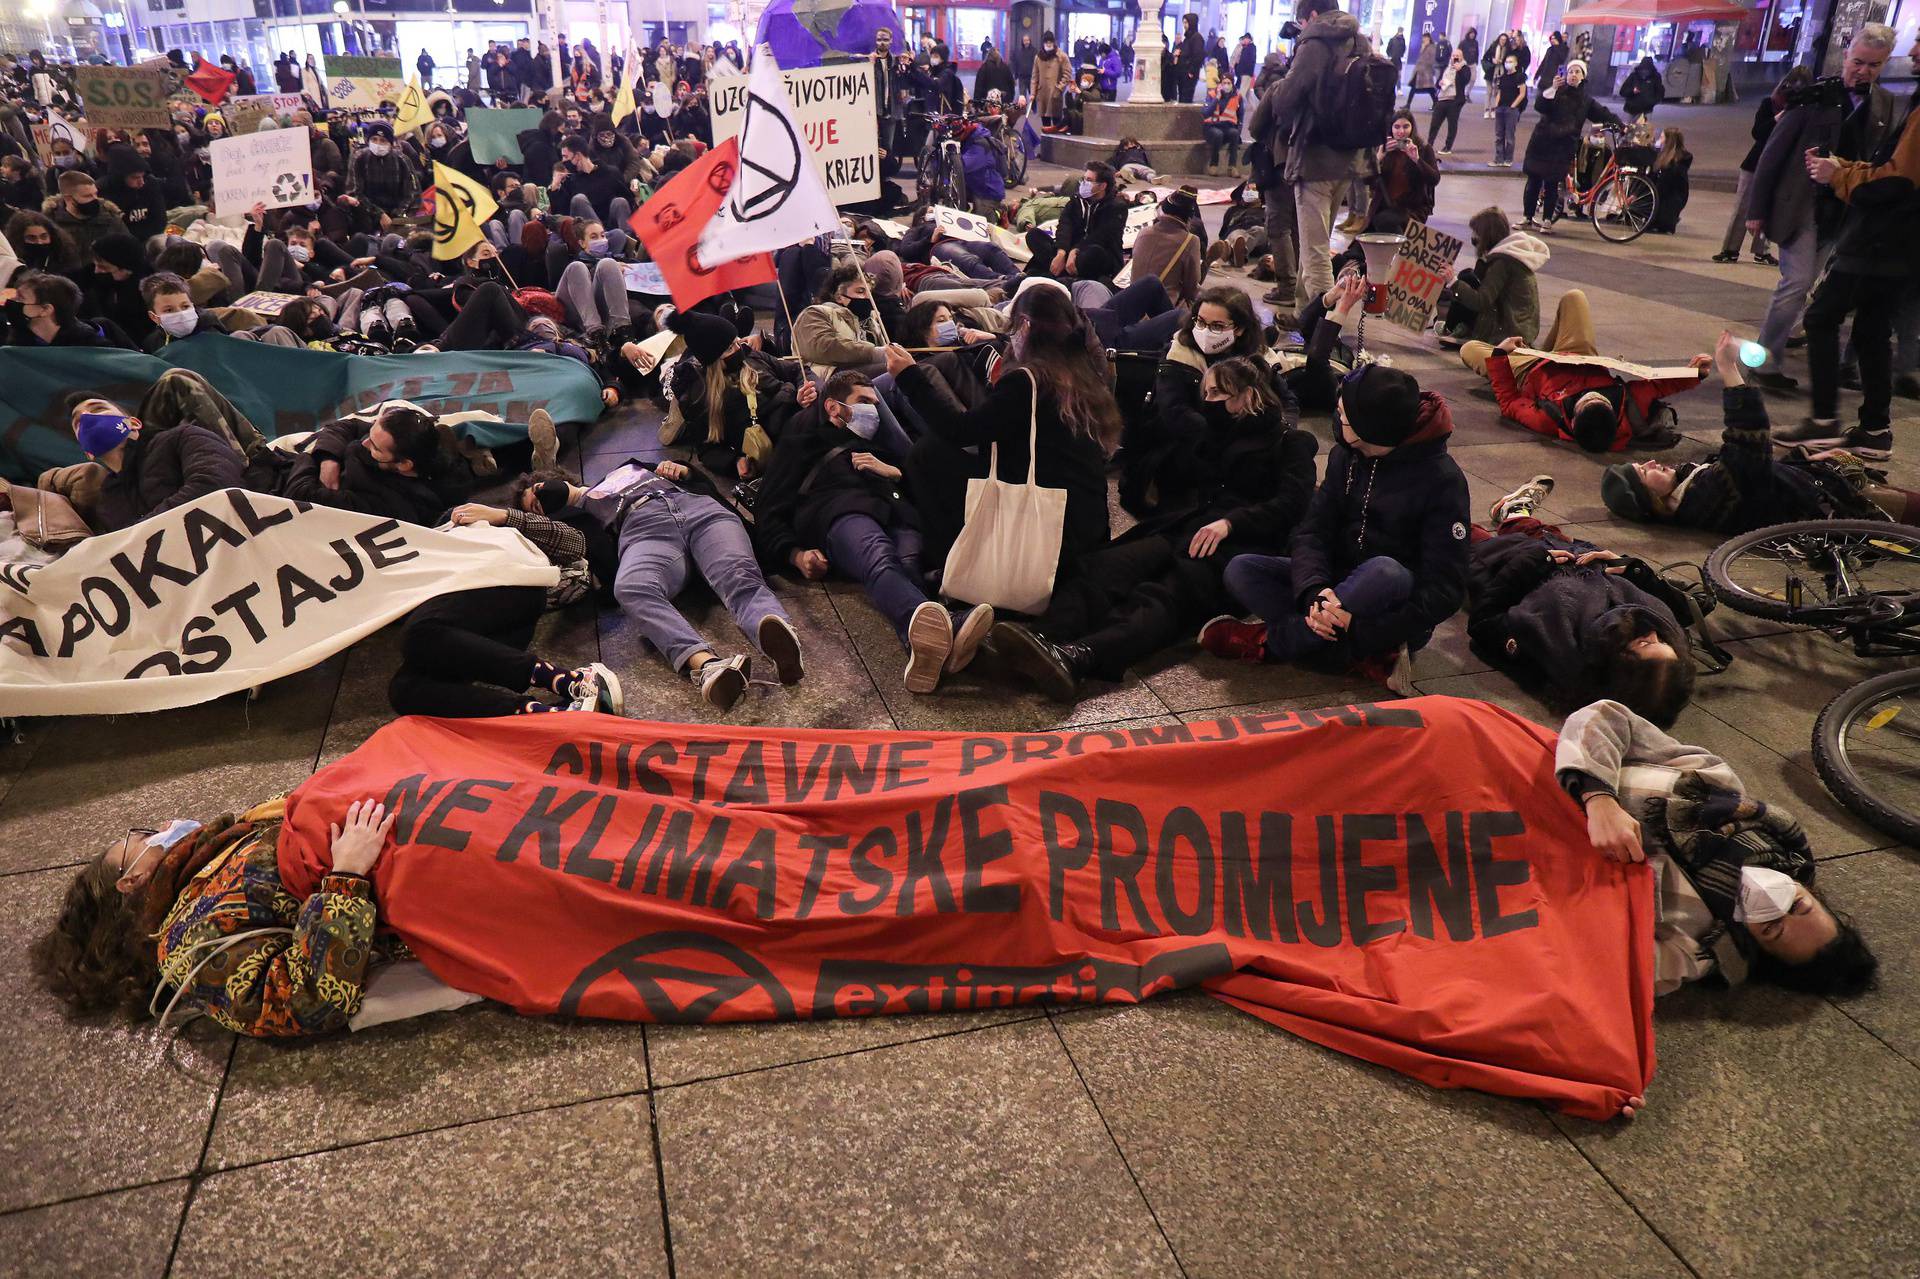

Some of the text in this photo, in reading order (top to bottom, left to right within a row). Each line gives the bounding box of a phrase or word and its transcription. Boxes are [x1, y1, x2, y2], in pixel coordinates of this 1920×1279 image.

[274, 97, 299, 110] STOP
[784, 72, 870, 108] ŽIVOTINJA
[803, 119, 840, 152] UJE
[825, 154, 875, 190] KRIZU
[1406, 221, 1464, 263] DA SAM
[1394, 260, 1444, 299] HOT
[1387, 281, 1433, 315] KAO OVAJ
[0, 488, 313, 658] APOKAL
[380, 772, 1540, 949] NE KLIMATSKE PROMJENE
